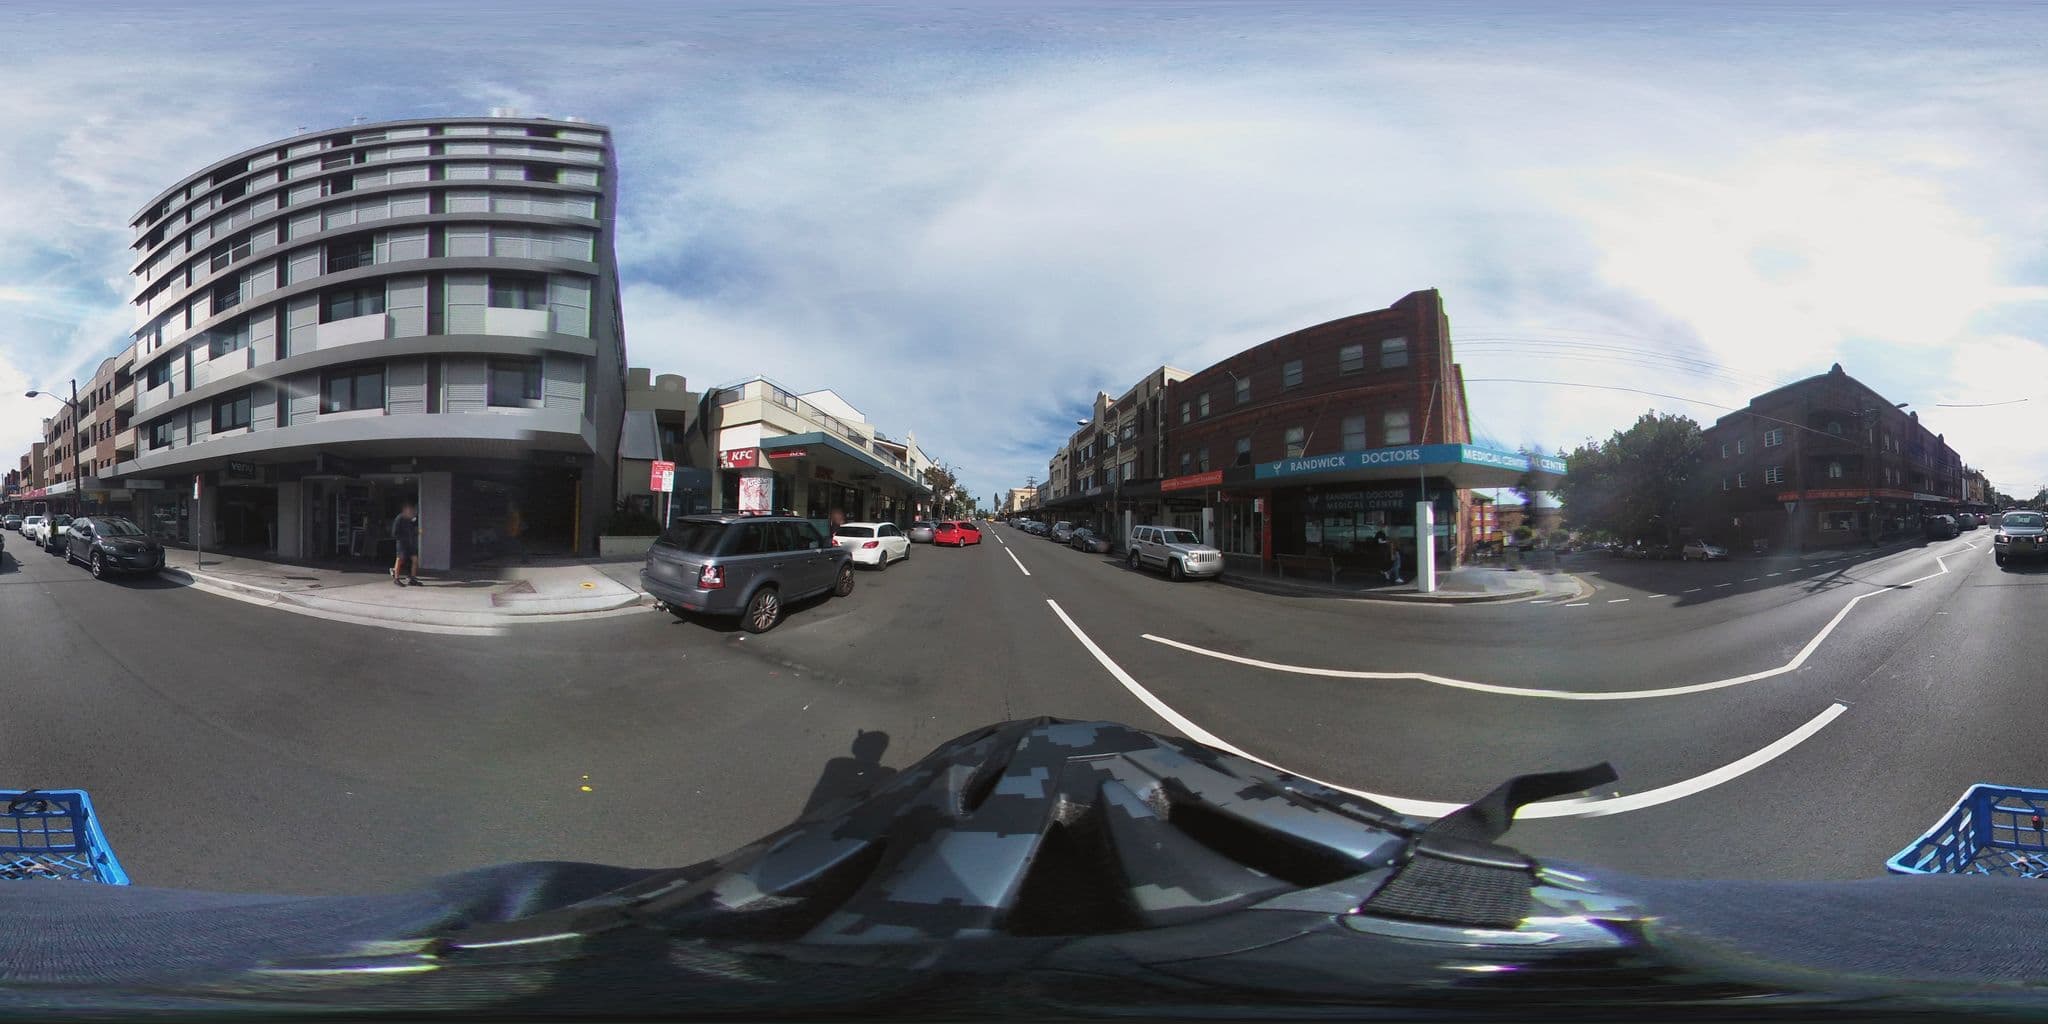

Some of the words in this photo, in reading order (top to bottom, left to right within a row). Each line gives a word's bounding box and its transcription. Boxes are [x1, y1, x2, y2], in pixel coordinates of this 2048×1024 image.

[732, 450, 752, 460] KFC
[1290, 456, 1345, 471] RANDWICK
[1361, 449, 1420, 464] DOCTORS
[1463, 449, 1501, 464] MEDICAL
